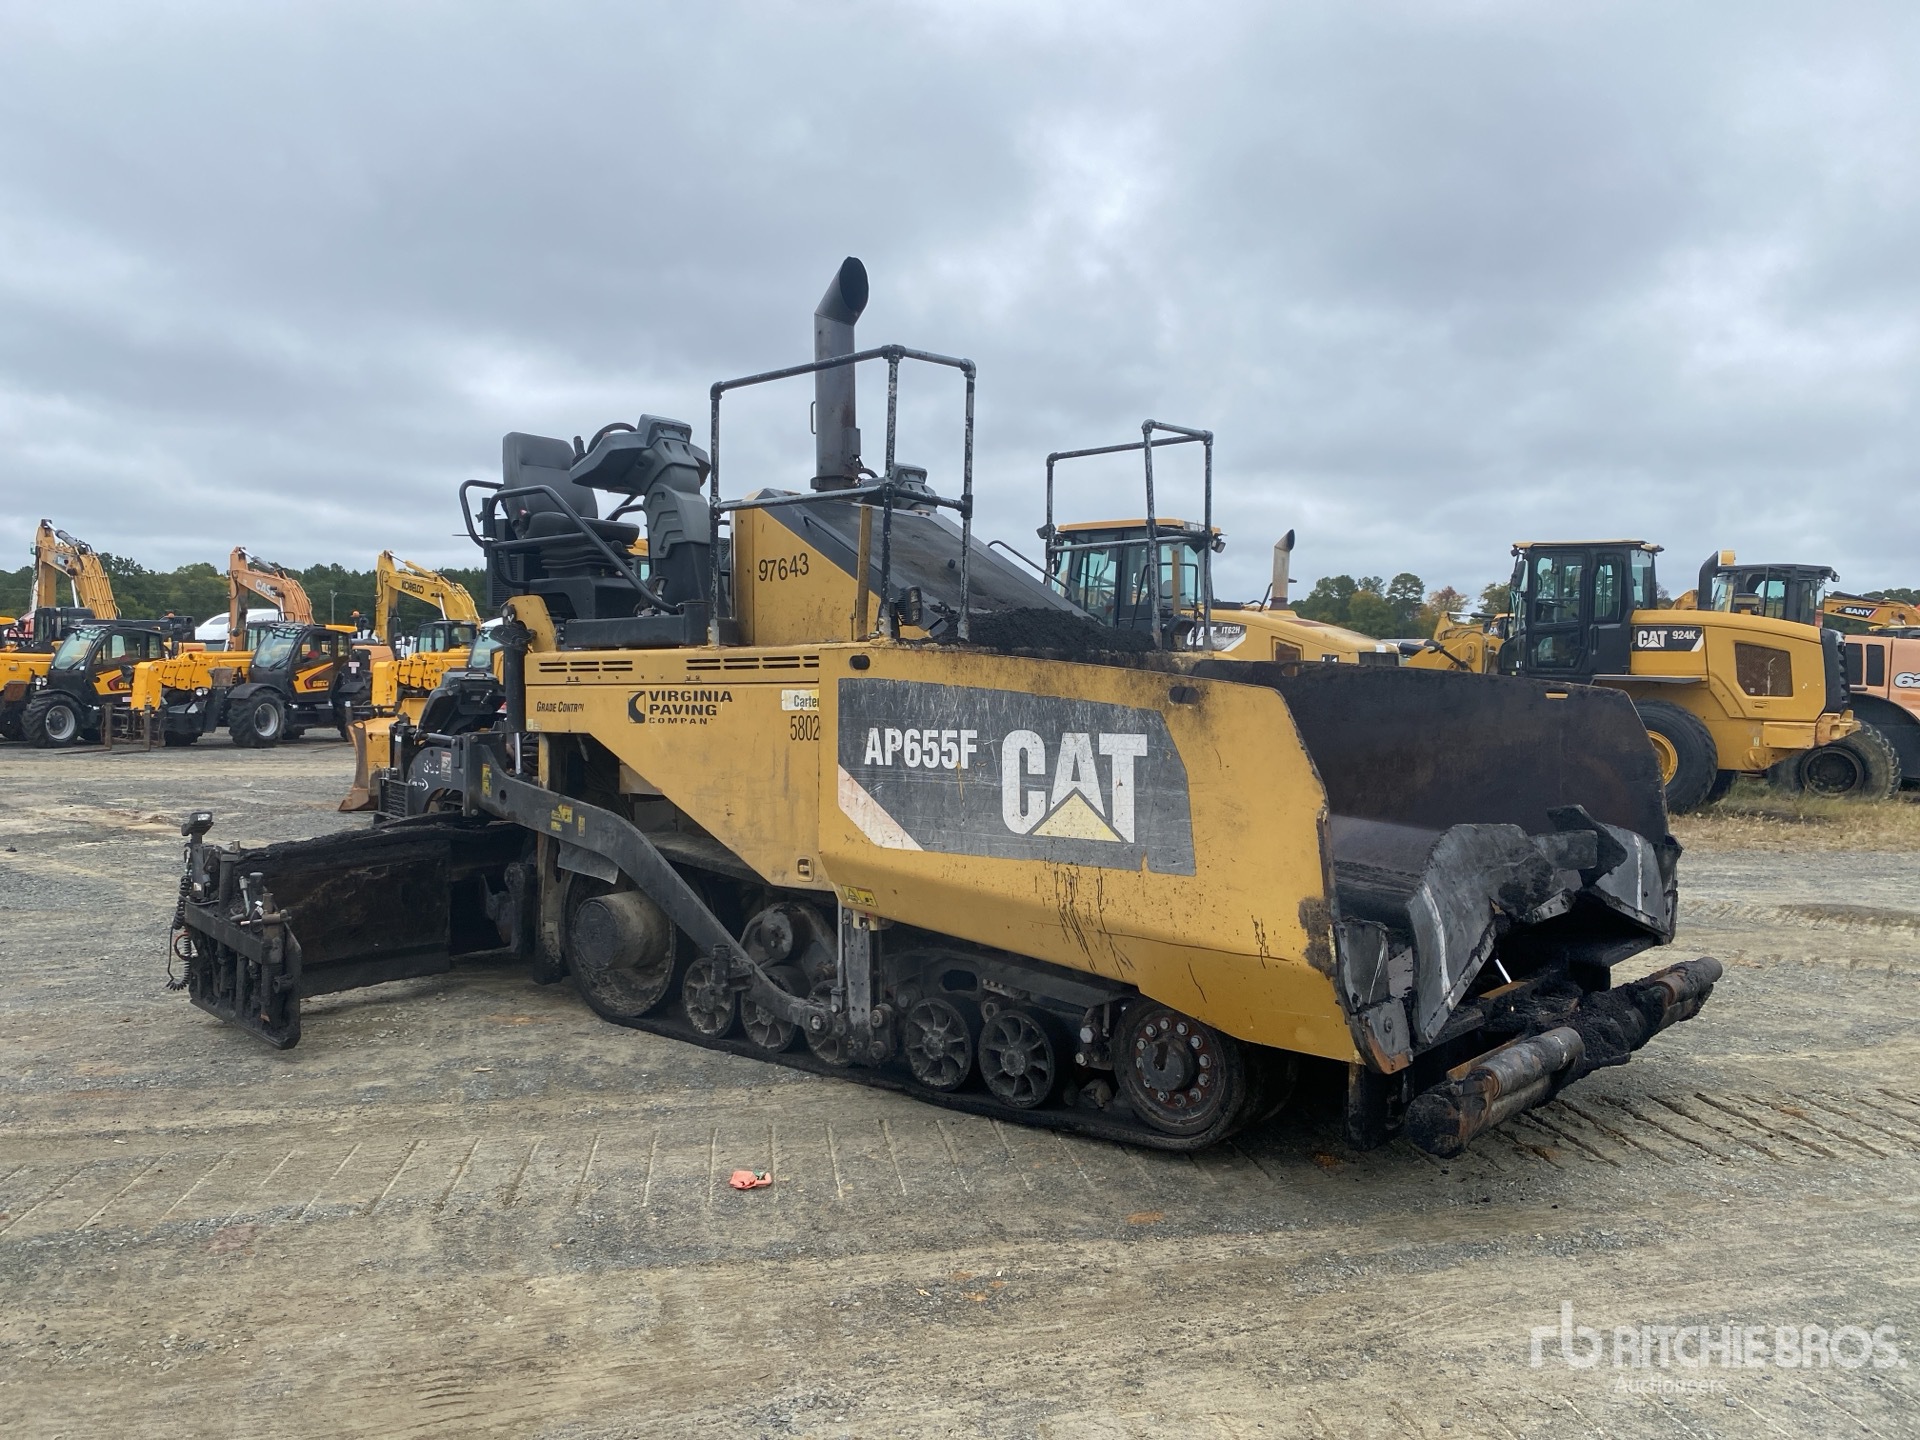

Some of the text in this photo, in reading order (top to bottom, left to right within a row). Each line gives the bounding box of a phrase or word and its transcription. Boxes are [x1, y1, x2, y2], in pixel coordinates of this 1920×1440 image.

[758, 552, 809, 582] 97643
[255, 579, 277, 598] CASE
[402, 579, 425, 595] KOBELCO
[1845, 607, 1872, 616] SANY
[1221, 626, 1241, 634] IT62H
[1637, 630, 1696, 648] CAT 924K
[648, 690, 733, 702] VIRGINIA
[649, 704, 717, 716] PAVING
[649, 717, 714, 725] COMPAN
[864, 728, 1147, 843] AP655F CAT
